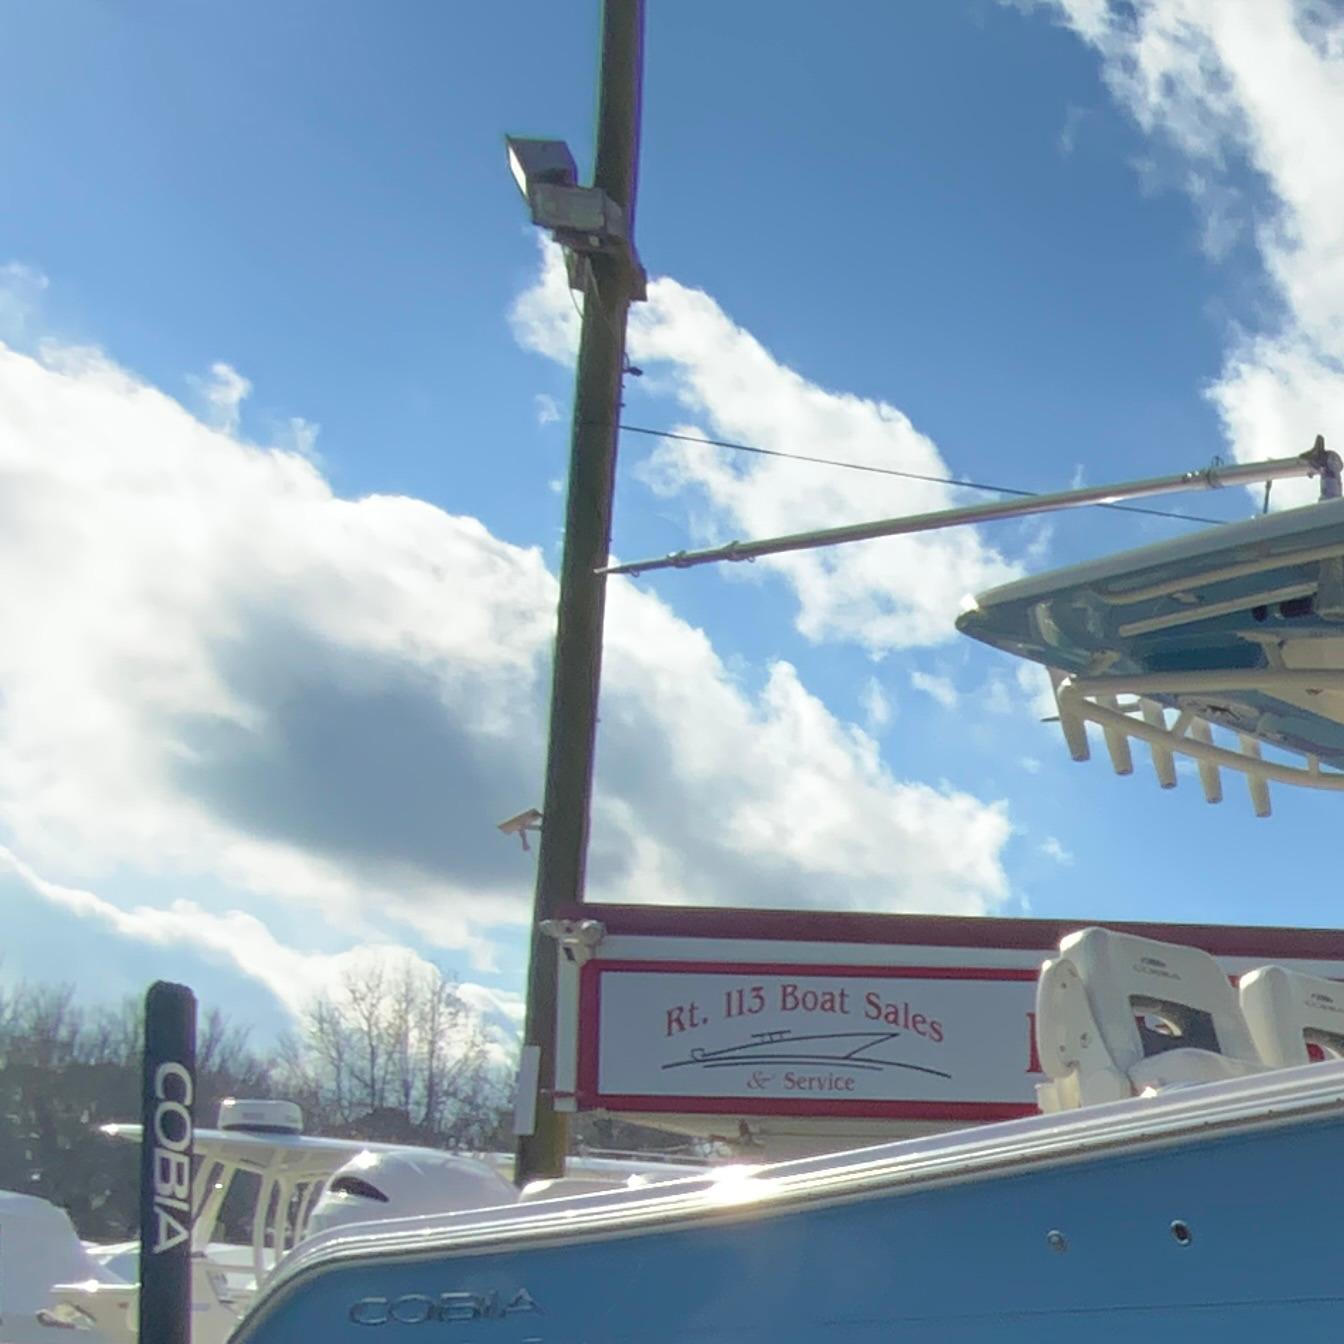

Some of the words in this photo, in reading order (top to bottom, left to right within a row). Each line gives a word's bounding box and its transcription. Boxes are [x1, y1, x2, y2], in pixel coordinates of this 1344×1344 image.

[665, 1001, 709, 1037] Rt.
[723, 985, 766, 1019] 113
[779, 983, 850, 1015] Boat
[863, 991, 945, 1043] Sales
[746, 1070, 772, 1090] &
[783, 1071, 856, 1092] Service
[154, 1061, 194, 1255] COBIA
[349, 1286, 547, 1327] COBIA
